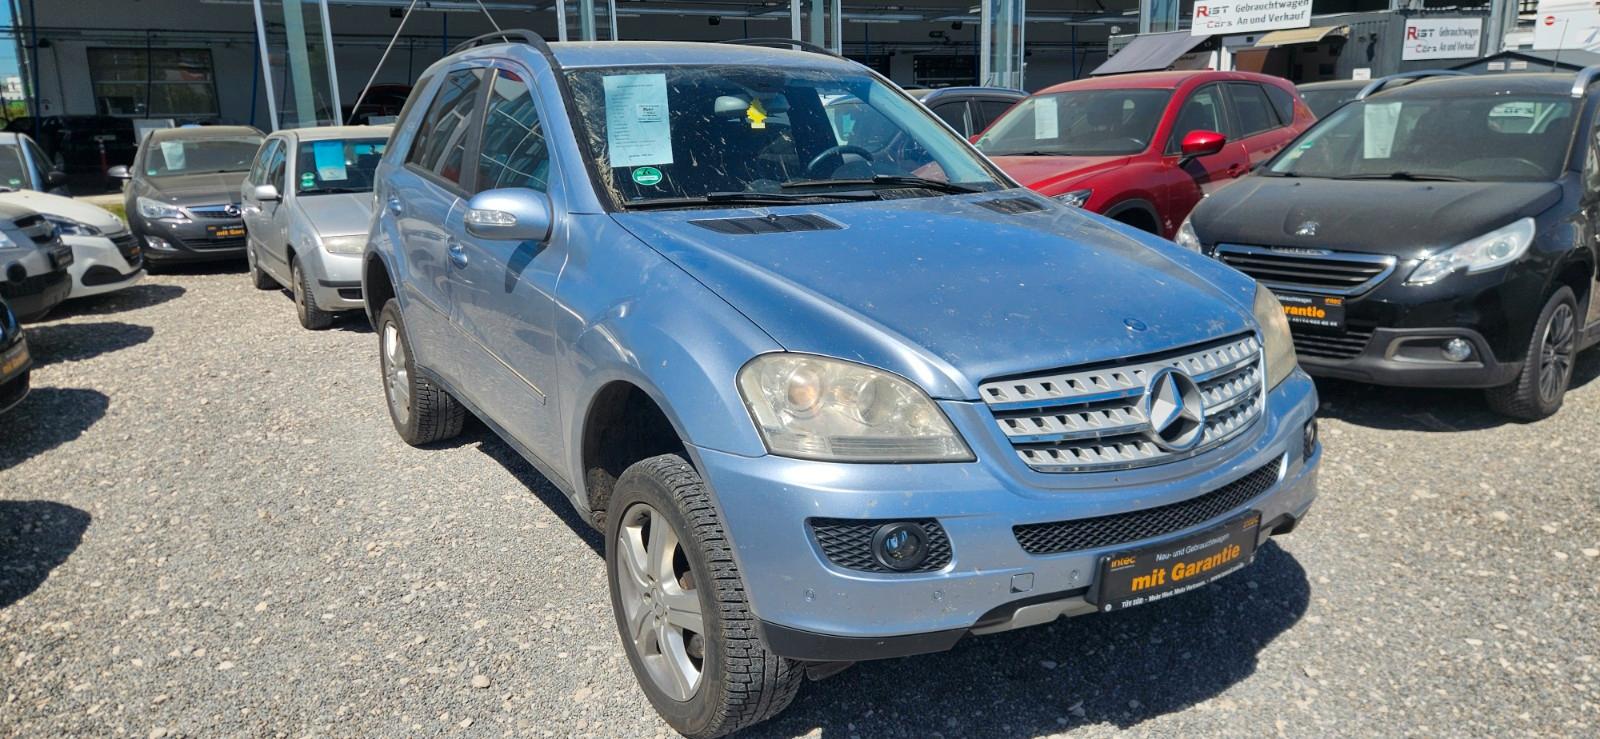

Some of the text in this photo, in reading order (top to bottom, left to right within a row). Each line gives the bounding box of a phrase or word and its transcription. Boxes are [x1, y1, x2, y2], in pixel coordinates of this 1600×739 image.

[1235, 0, 1309, 13] Gebrauchtwagen
[1236, 10, 1305, 25] An und Verkauf
[1172, 548, 1185, 557] und
[1111, 556, 1136, 568] intec
[1131, 568, 1166, 592] mit
[1171, 544, 1241, 581] Garantie
